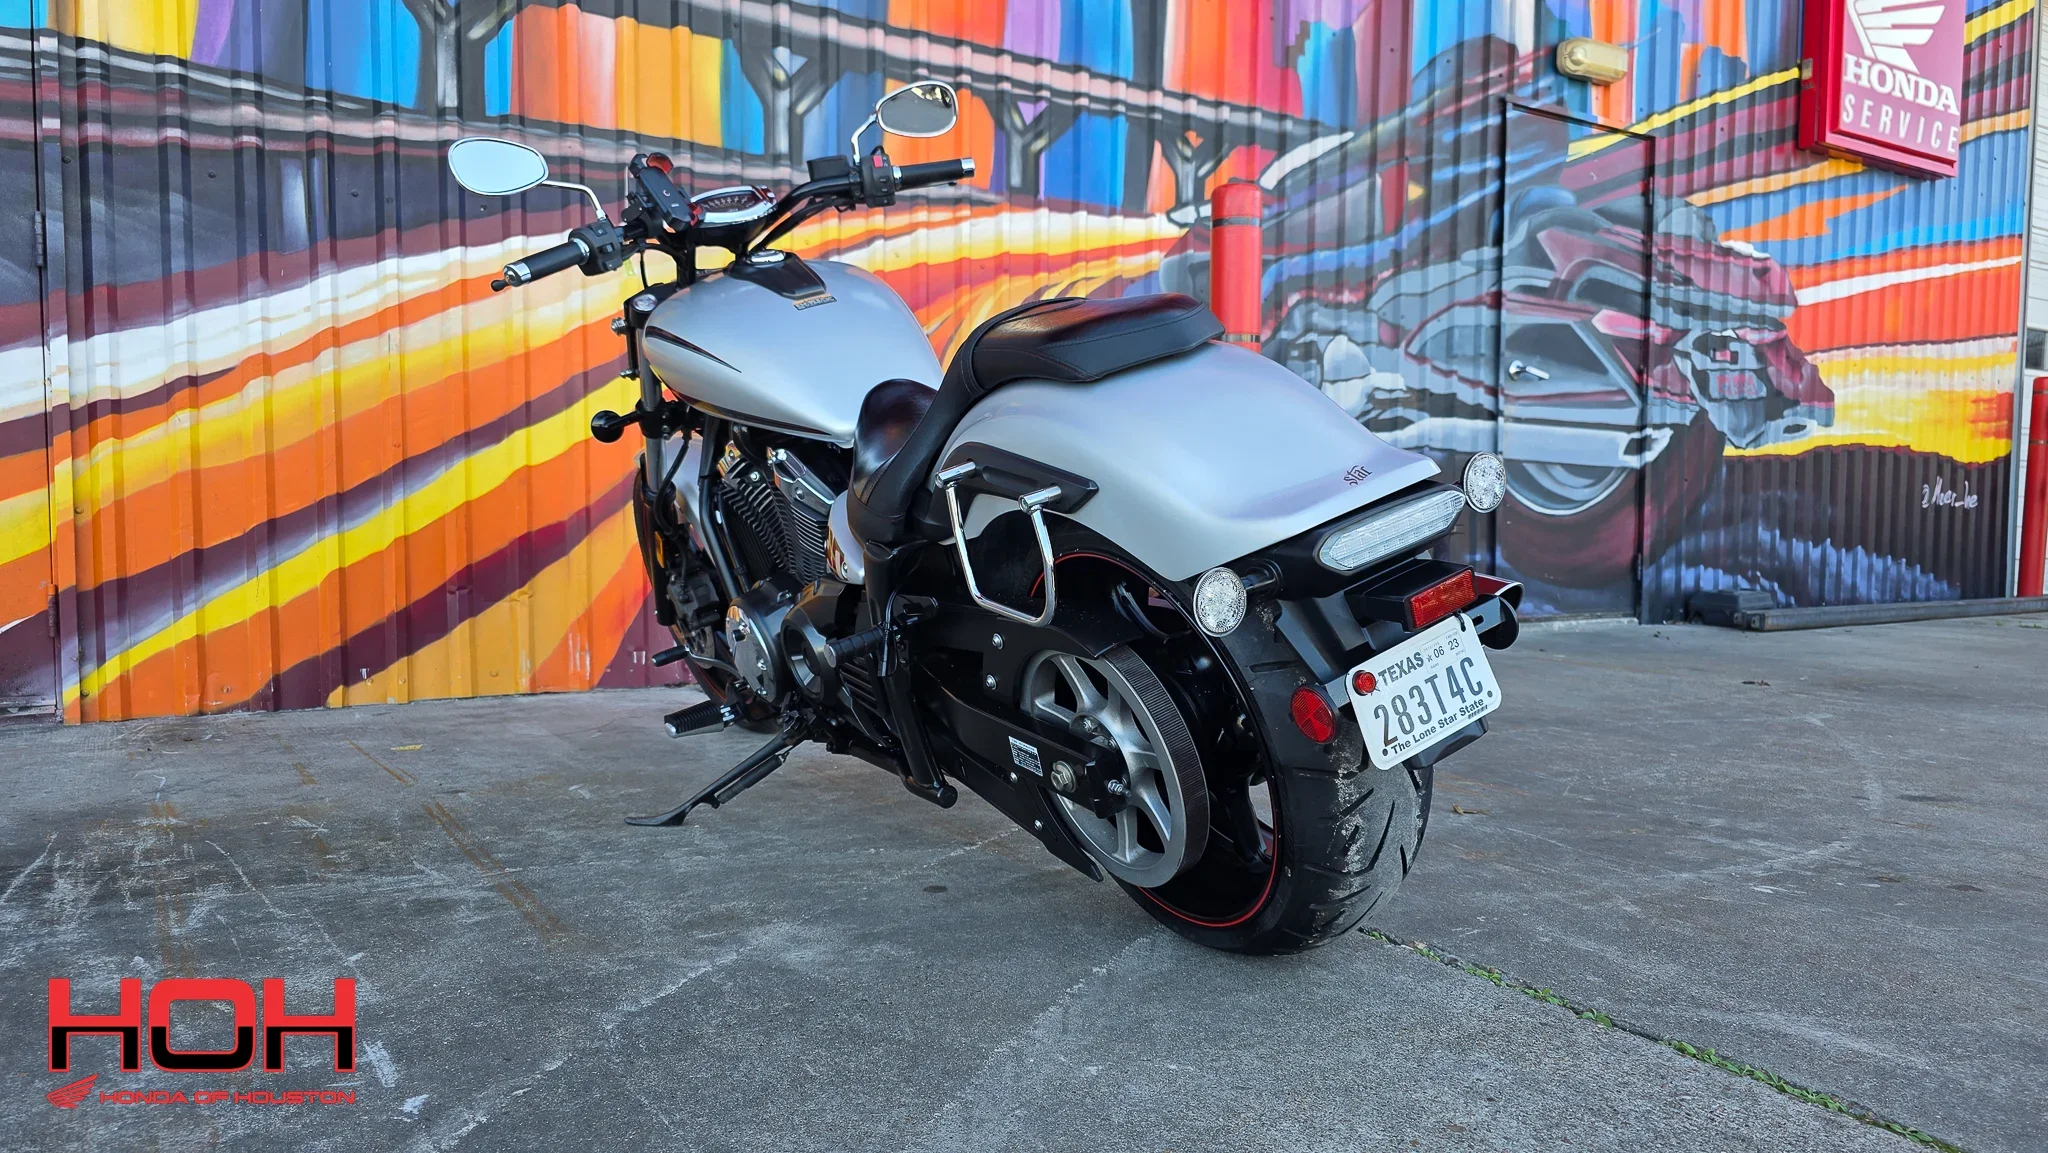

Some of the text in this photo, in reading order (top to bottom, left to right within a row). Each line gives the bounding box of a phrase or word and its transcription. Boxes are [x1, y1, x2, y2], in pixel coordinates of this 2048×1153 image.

[1843, 53, 1960, 115] HONDA
[1842, 93, 1959, 153] SERVICE
[1378, 652, 1424, 686] TEXAS
[1433, 645, 1445, 658] 06
[1447, 638, 1460, 651] 23
[1374, 656, 1484, 747] 283T4C
[1391, 740, 1411, 754] The
[1412, 725, 1437, 743] Lone
[1437, 712, 1458, 728] Star
[1459, 698, 1484, 716] State
